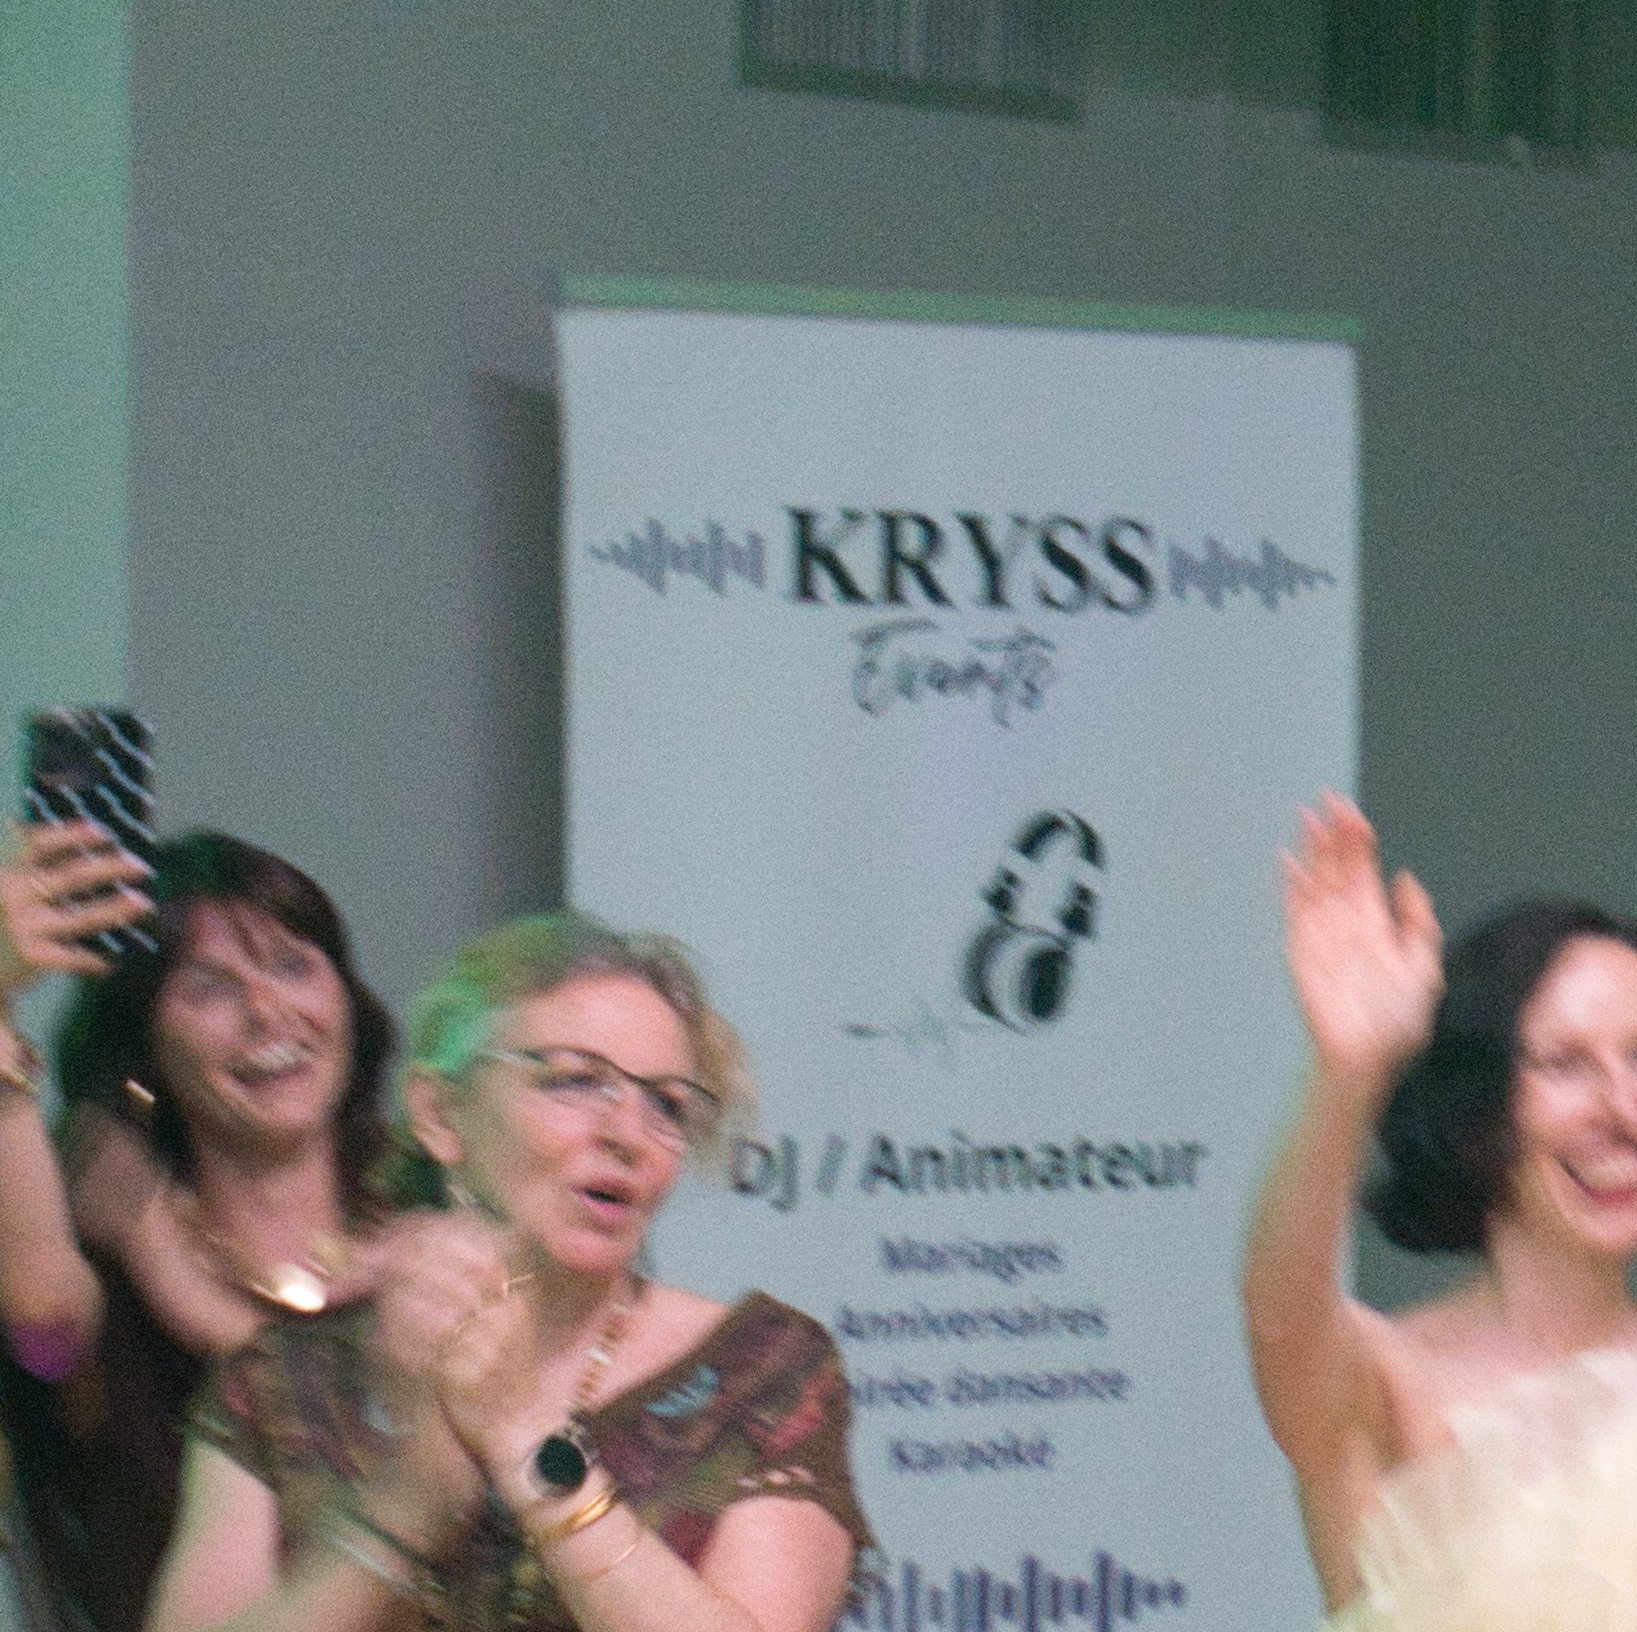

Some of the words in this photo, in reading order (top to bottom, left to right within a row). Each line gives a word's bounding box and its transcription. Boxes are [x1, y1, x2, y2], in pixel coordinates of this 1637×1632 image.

[785, 506, 1156, 614] KRYSS
[729, 1134, 798, 1212] DJ
[860, 1128, 1208, 1195] Animateur
[879, 1236, 1066, 1283] Mariages
[836, 1300, 1109, 1341] Anniversaires
